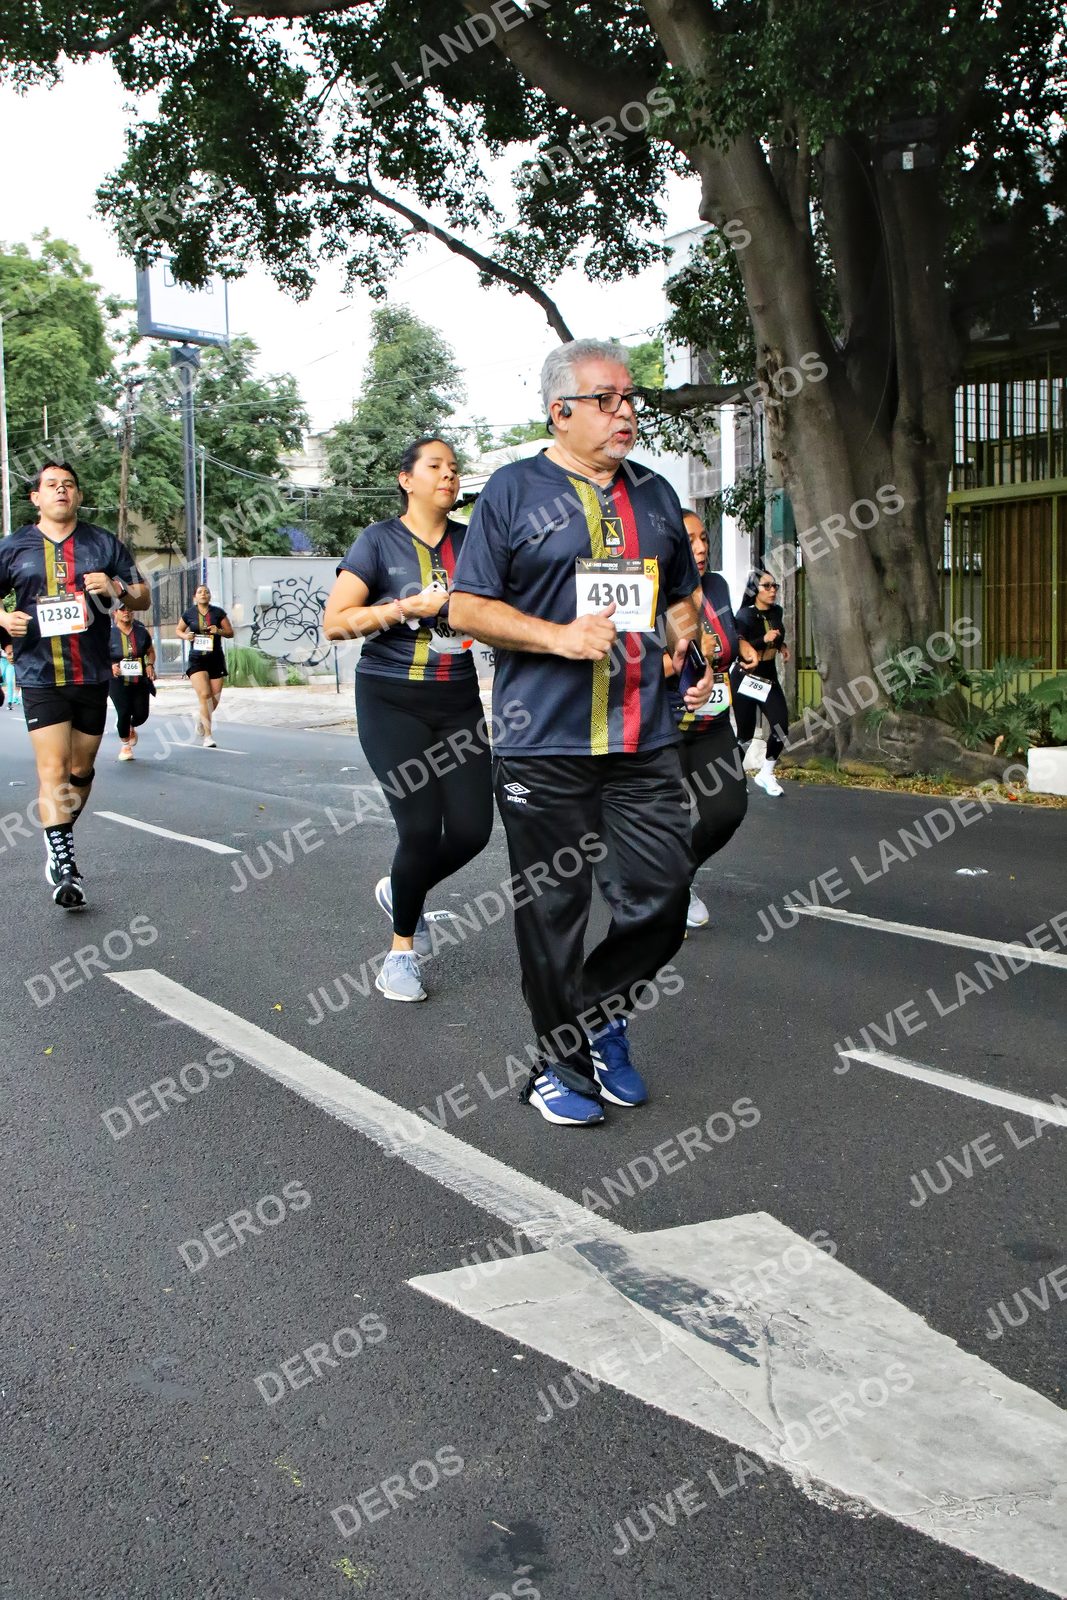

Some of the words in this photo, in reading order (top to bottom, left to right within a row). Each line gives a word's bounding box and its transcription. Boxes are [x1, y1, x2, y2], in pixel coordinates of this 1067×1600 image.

[645, 565, 656, 573] 5K
[273, 576, 313, 591] TOY
[587, 583, 640, 606] 4301
[40, 606, 80, 622] 12382
[748, 681, 764, 691] 789
[709, 690, 723, 703] 23
